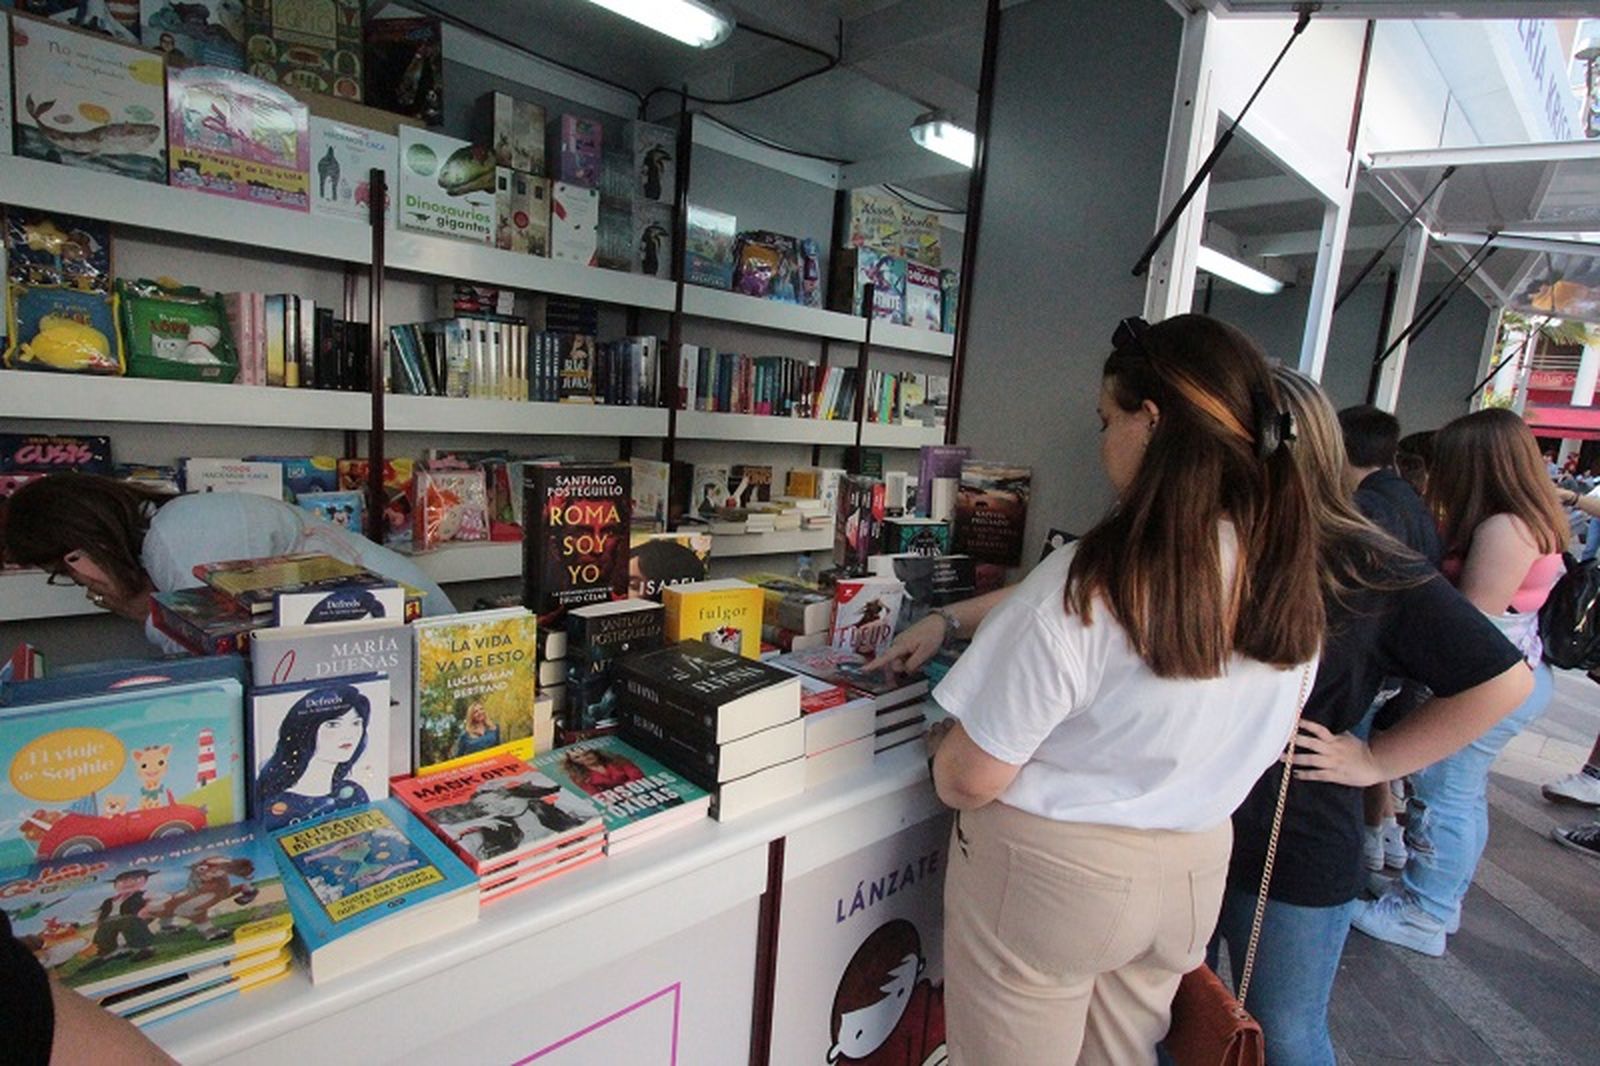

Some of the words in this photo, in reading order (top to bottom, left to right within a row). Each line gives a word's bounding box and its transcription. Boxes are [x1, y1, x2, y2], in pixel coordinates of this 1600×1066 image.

[406, 193, 491, 224] Dinosaurios
[436, 214, 491, 235] gigantes
[547, 485, 623, 498] POSTEGUILLO
[555, 475, 617, 488] SANTIAGO
[550, 504, 621, 527] ROMA
[563, 533, 608, 556] SOY
[568, 563, 600, 585] YO
[698, 605, 748, 620] fulgor
[331, 635, 399, 659] MARÍA
[451, 640, 471, 654] LA
[474, 633, 513, 650] VIDA
[315, 652, 400, 676] DUEÑAS
[435, 660, 458, 674] VA
[462, 655, 483, 670] DE
[487, 649, 525, 667] ESTO
[836, 850, 940, 923] LÁNZATE
